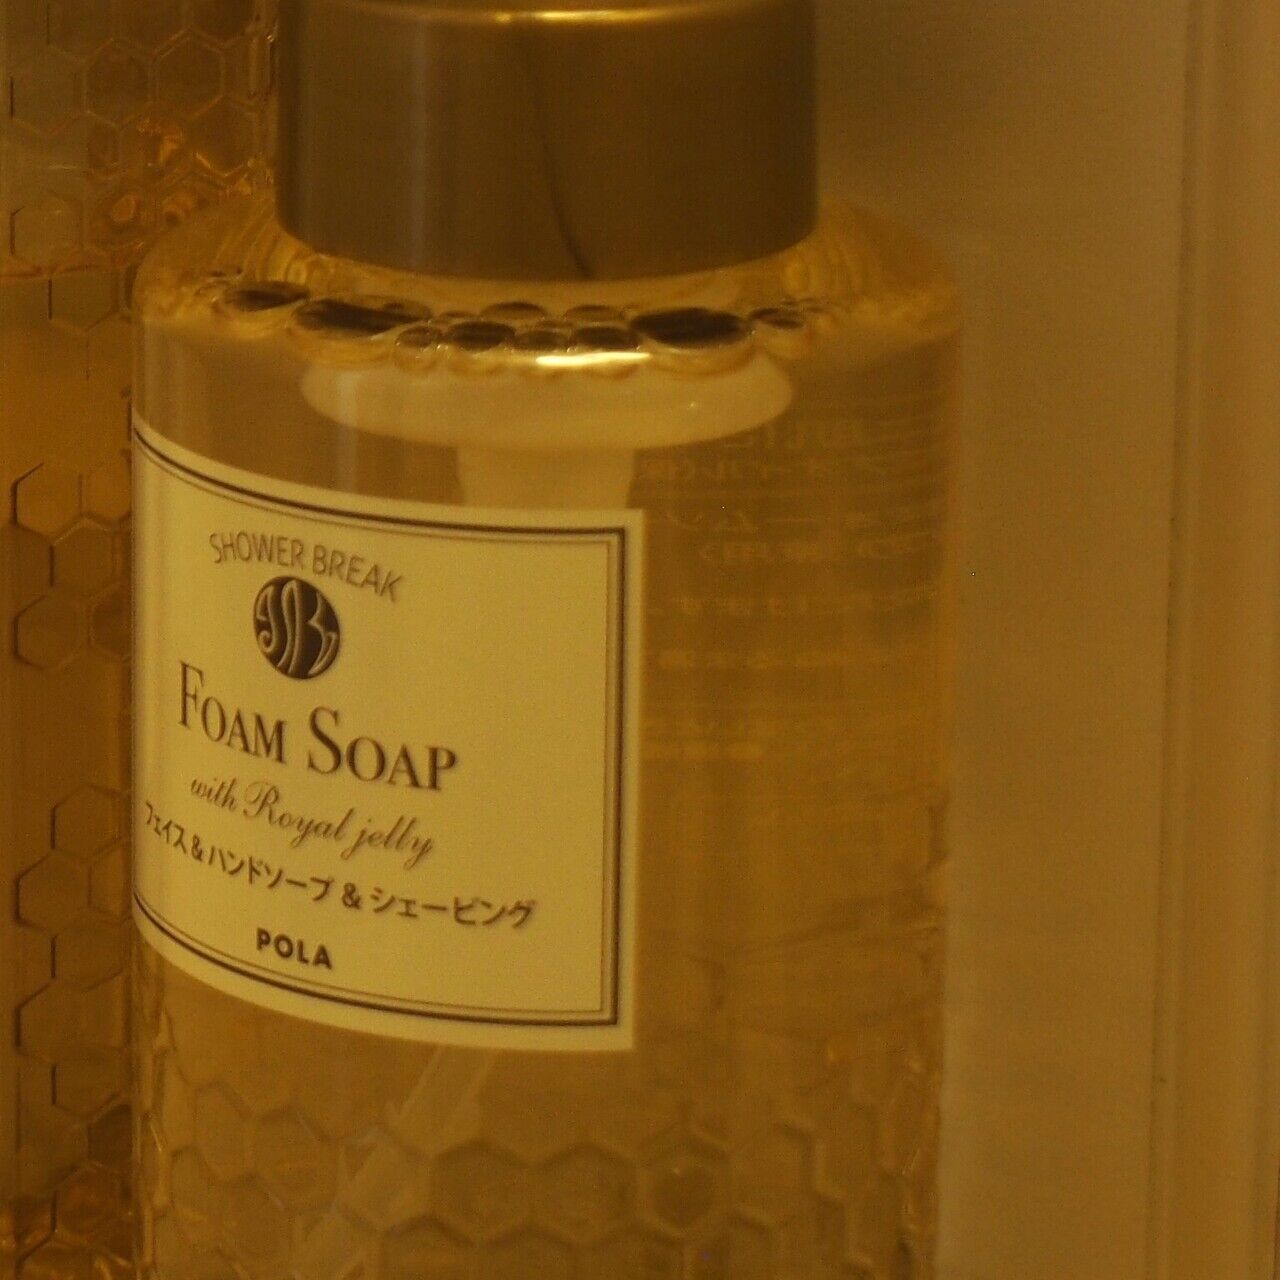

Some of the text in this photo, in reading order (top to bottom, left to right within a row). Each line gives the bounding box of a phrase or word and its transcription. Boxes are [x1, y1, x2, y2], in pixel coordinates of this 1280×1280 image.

[209, 531, 403, 603] SHOWER BREAK
[179, 660, 458, 791] FOAM SOAP
[190, 776, 433, 870] with Royal jelly
[256, 927, 333, 970] POLA
